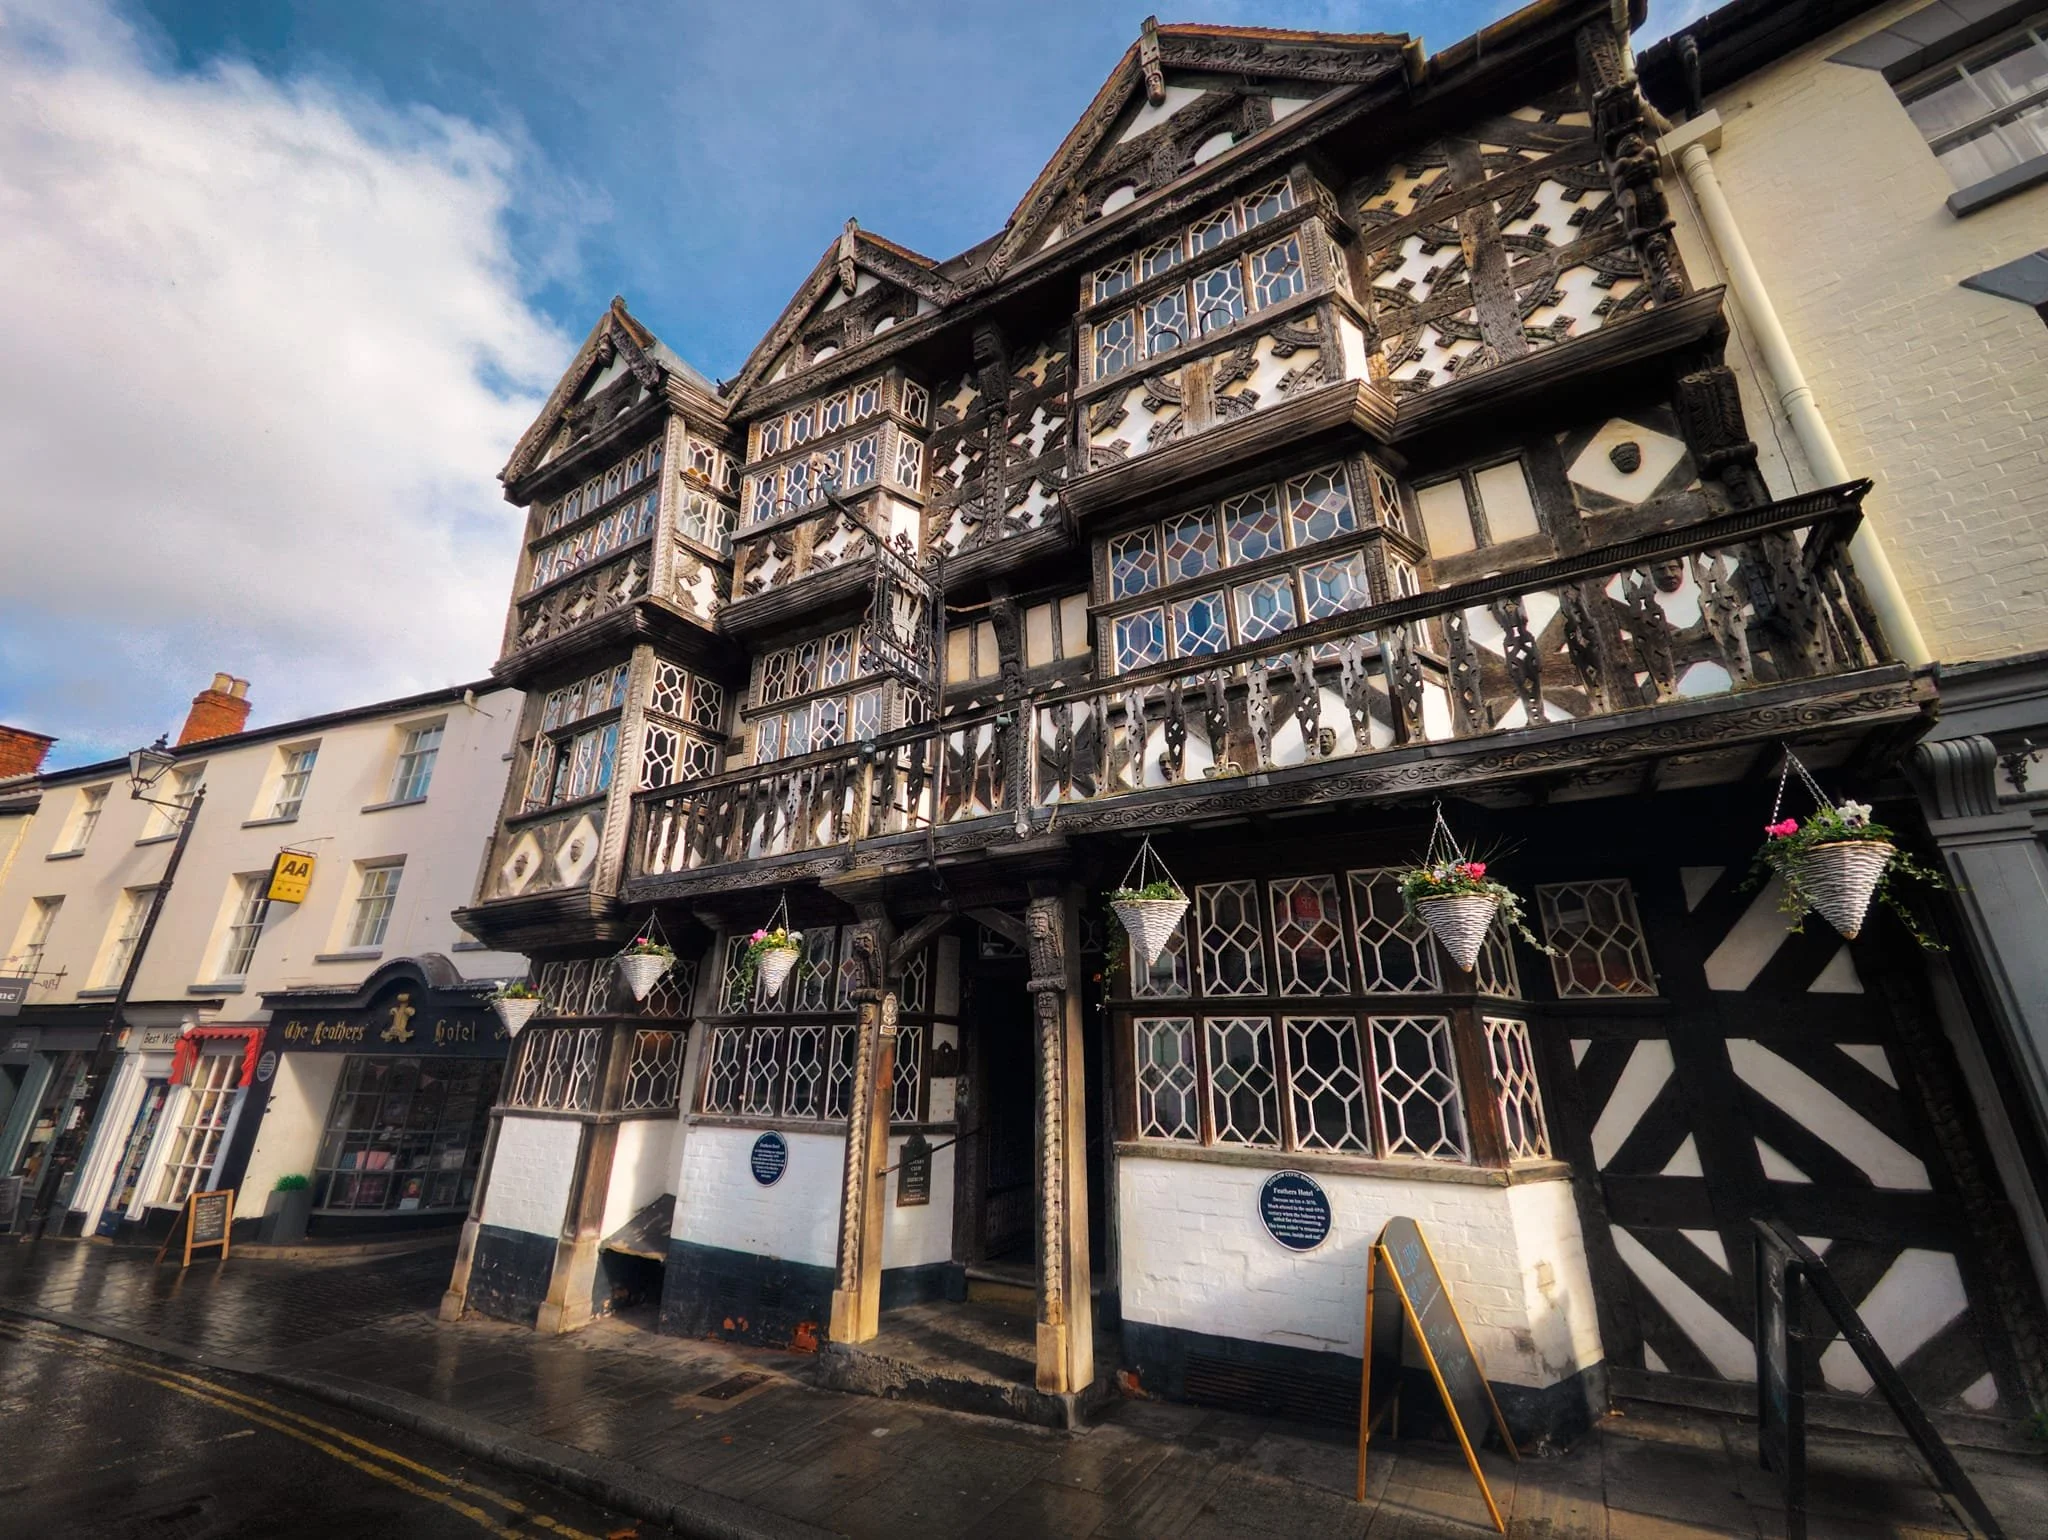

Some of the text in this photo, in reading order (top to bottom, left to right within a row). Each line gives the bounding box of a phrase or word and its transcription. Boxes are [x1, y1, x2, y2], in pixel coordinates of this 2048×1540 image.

[880, 550, 930, 598] FEATHERS
[880, 641, 922, 678] HOTEL
[281, 861, 309, 877] AA
[143, 1031, 160, 1044] Best
[285, 1021, 308, 1044] The
[433, 1019, 475, 1046] Hotel
[1298, 1189, 1314, 1197] Hotel
